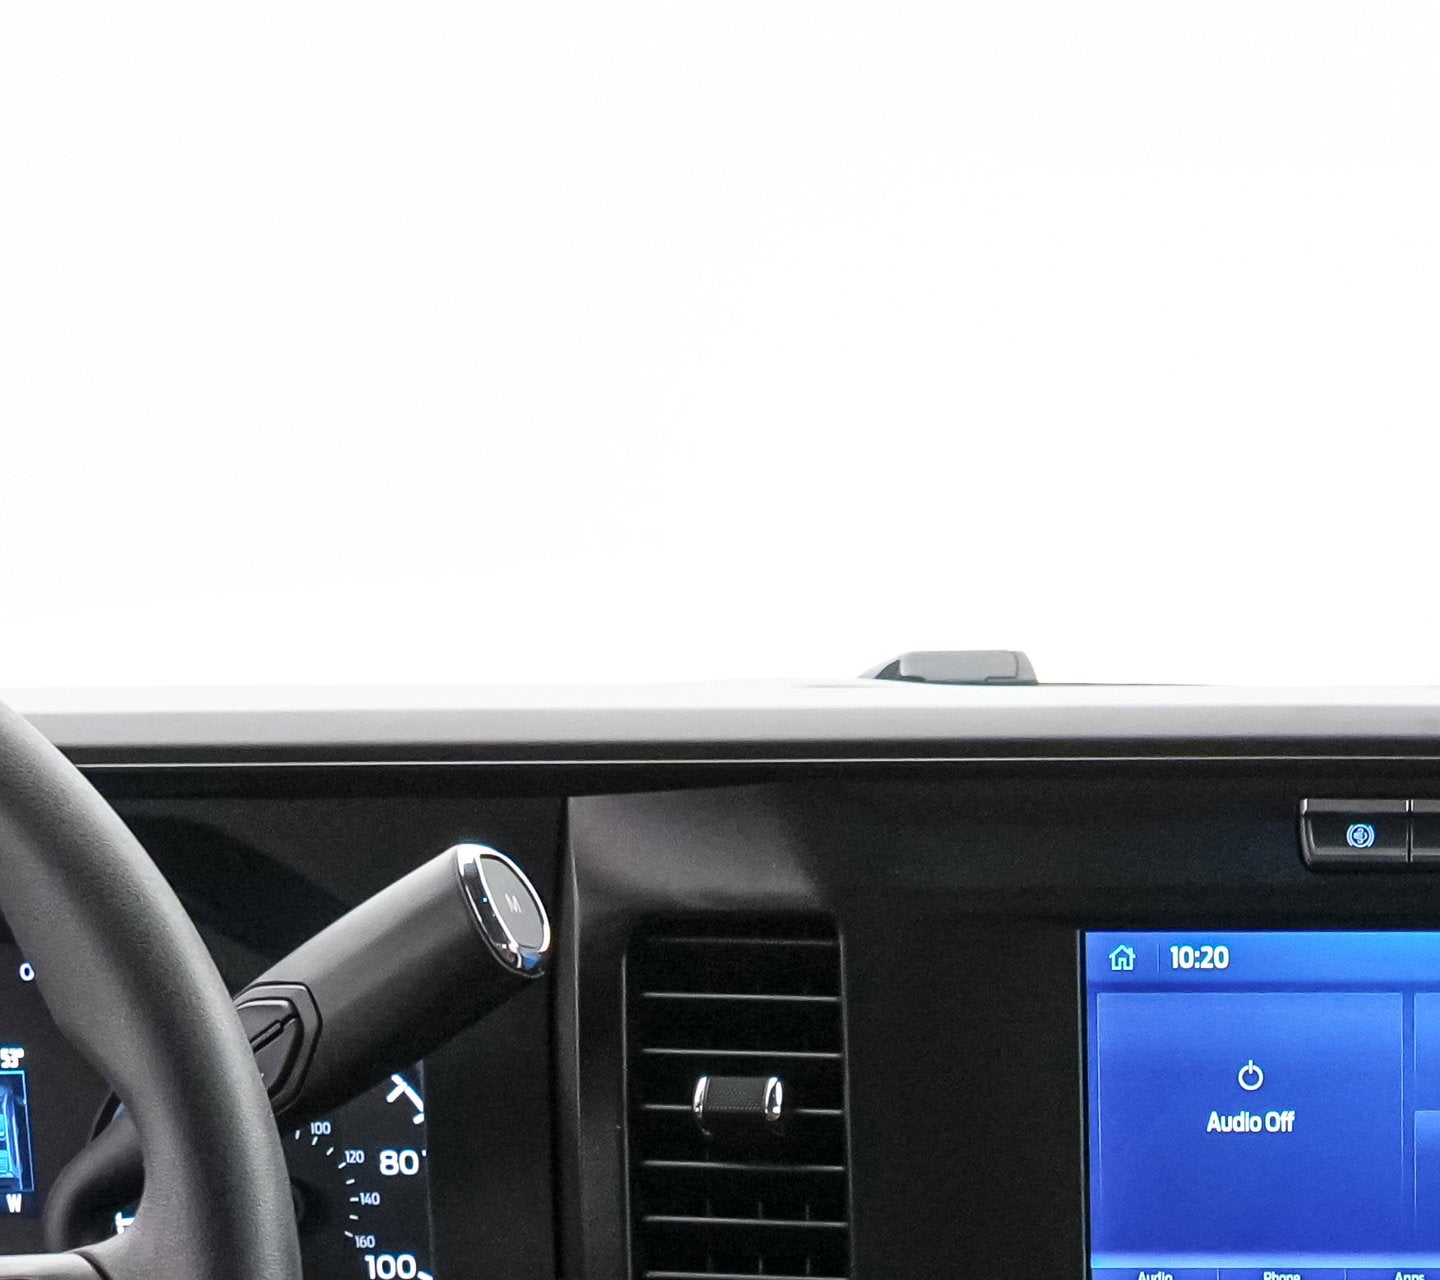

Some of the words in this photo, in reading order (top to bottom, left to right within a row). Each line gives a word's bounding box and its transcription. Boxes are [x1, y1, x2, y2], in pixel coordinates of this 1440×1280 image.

[1169, 946, 1230, 969] 10:20
[311, 1121, 331, 1135] 100
[1206, 1111, 1261, 1133] Audio
[1264, 1110, 1295, 1133] Off
[345, 1150, 364, 1163] 120
[379, 1150, 419, 1176] 80
[7, 1194, 23, 1212] W
[359, 1192, 380, 1205] 140
[355, 1235, 376, 1248] 160
[364, 1254, 417, 1280] 100
